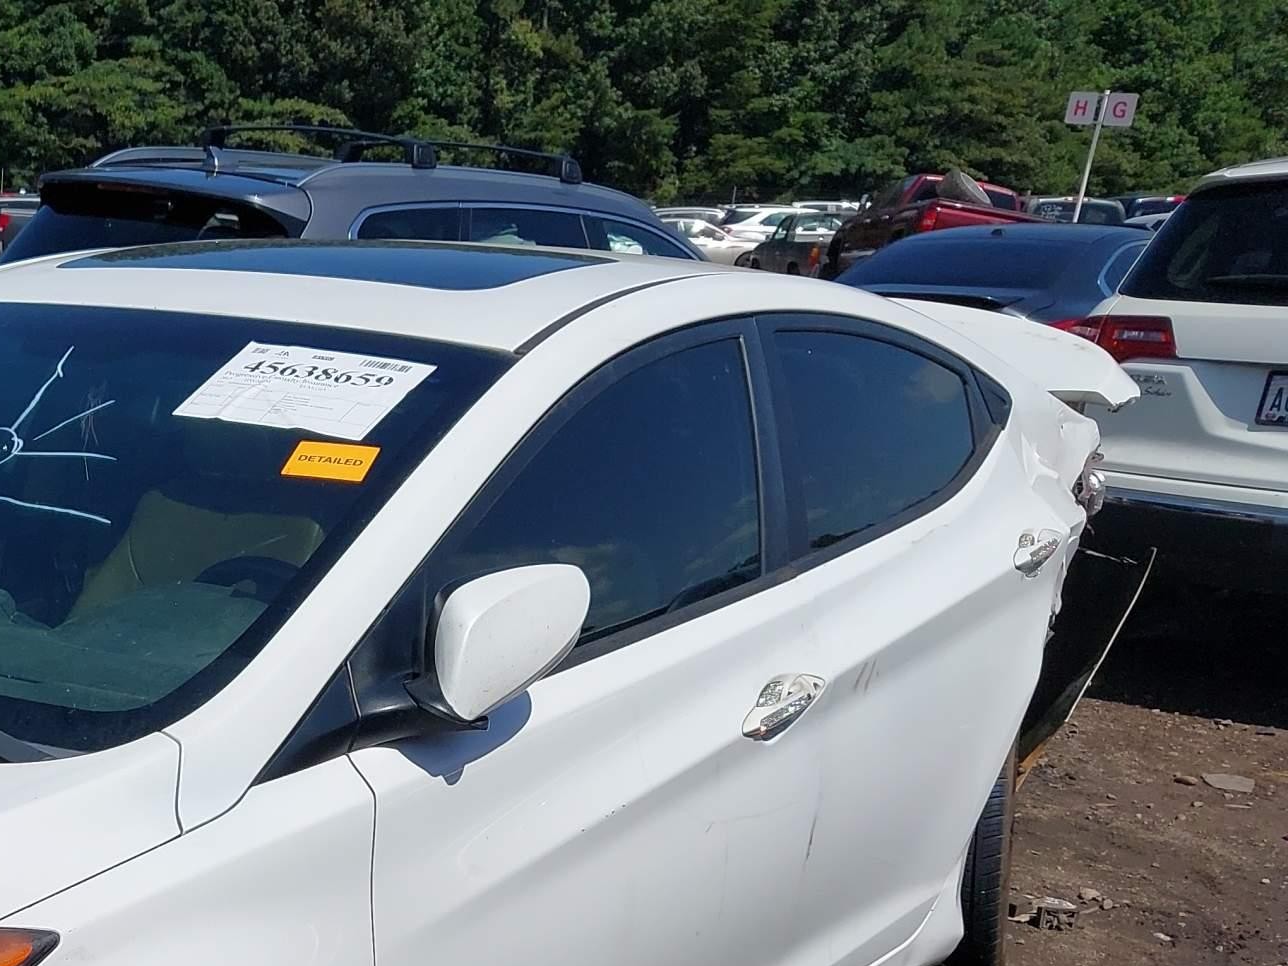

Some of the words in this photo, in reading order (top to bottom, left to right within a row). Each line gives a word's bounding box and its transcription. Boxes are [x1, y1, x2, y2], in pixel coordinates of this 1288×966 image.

[1074, 100, 1088, 116] H
[1113, 101, 1128, 118] G
[243, 360, 395, 388] 45638659
[297, 454, 364, 467] DETAILED
